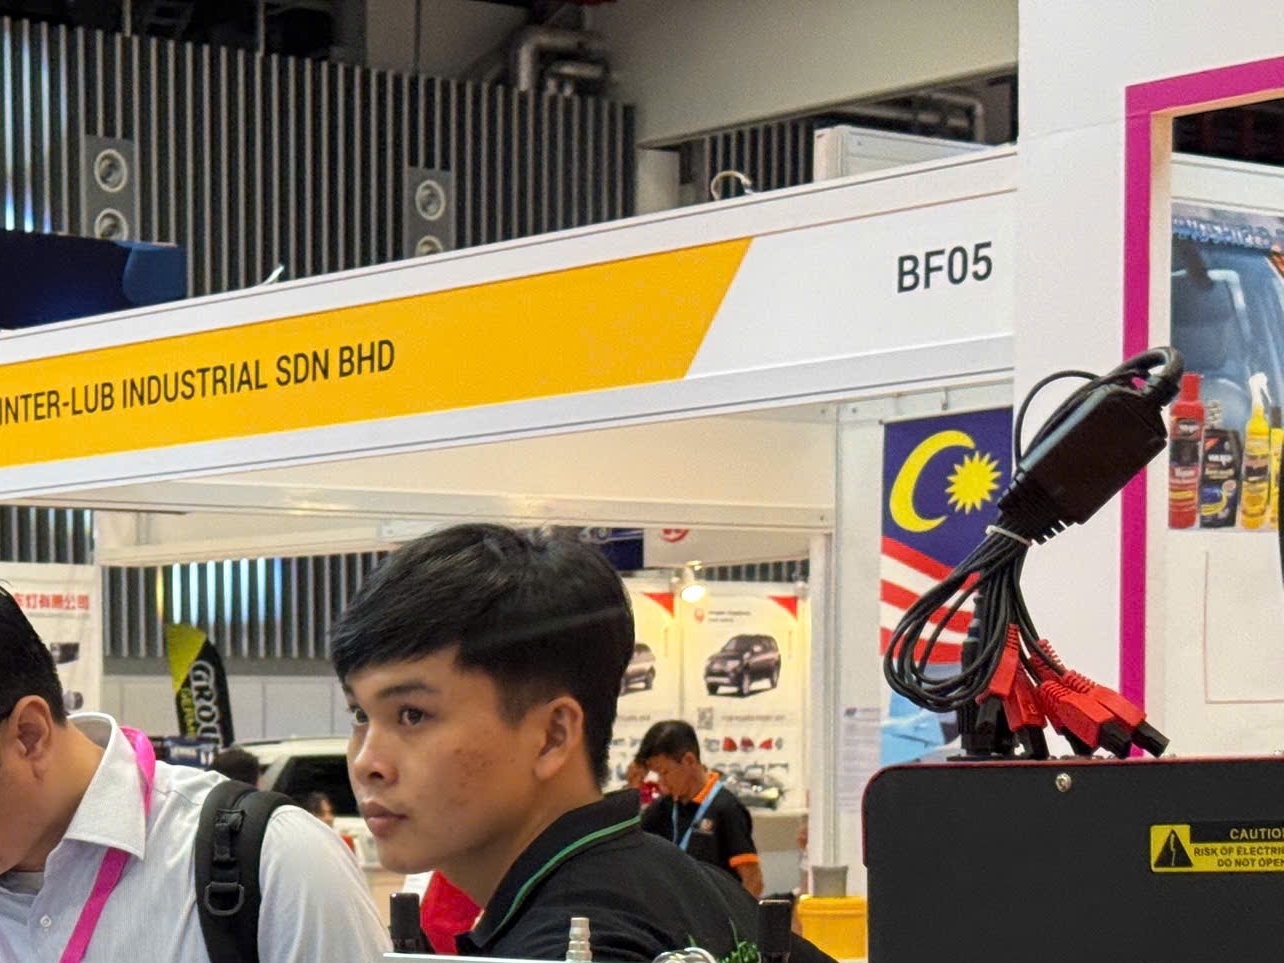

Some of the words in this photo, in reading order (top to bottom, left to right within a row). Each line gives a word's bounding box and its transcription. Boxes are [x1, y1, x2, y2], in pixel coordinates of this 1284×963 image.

[897, 241, 993, 294] BF05
[122, 360, 268, 410] INDUSTRIAL
[275, 349, 329, 387] SDN
[339, 338, 395, 378] BHD
[1230, 828, 1284, 840] CAUTIO
[1194, 847, 1217, 857] RISK
[1220, 847, 1235, 856] OF
[1218, 859, 1232, 867] DO
[1235, 858, 1256, 867] NOT
